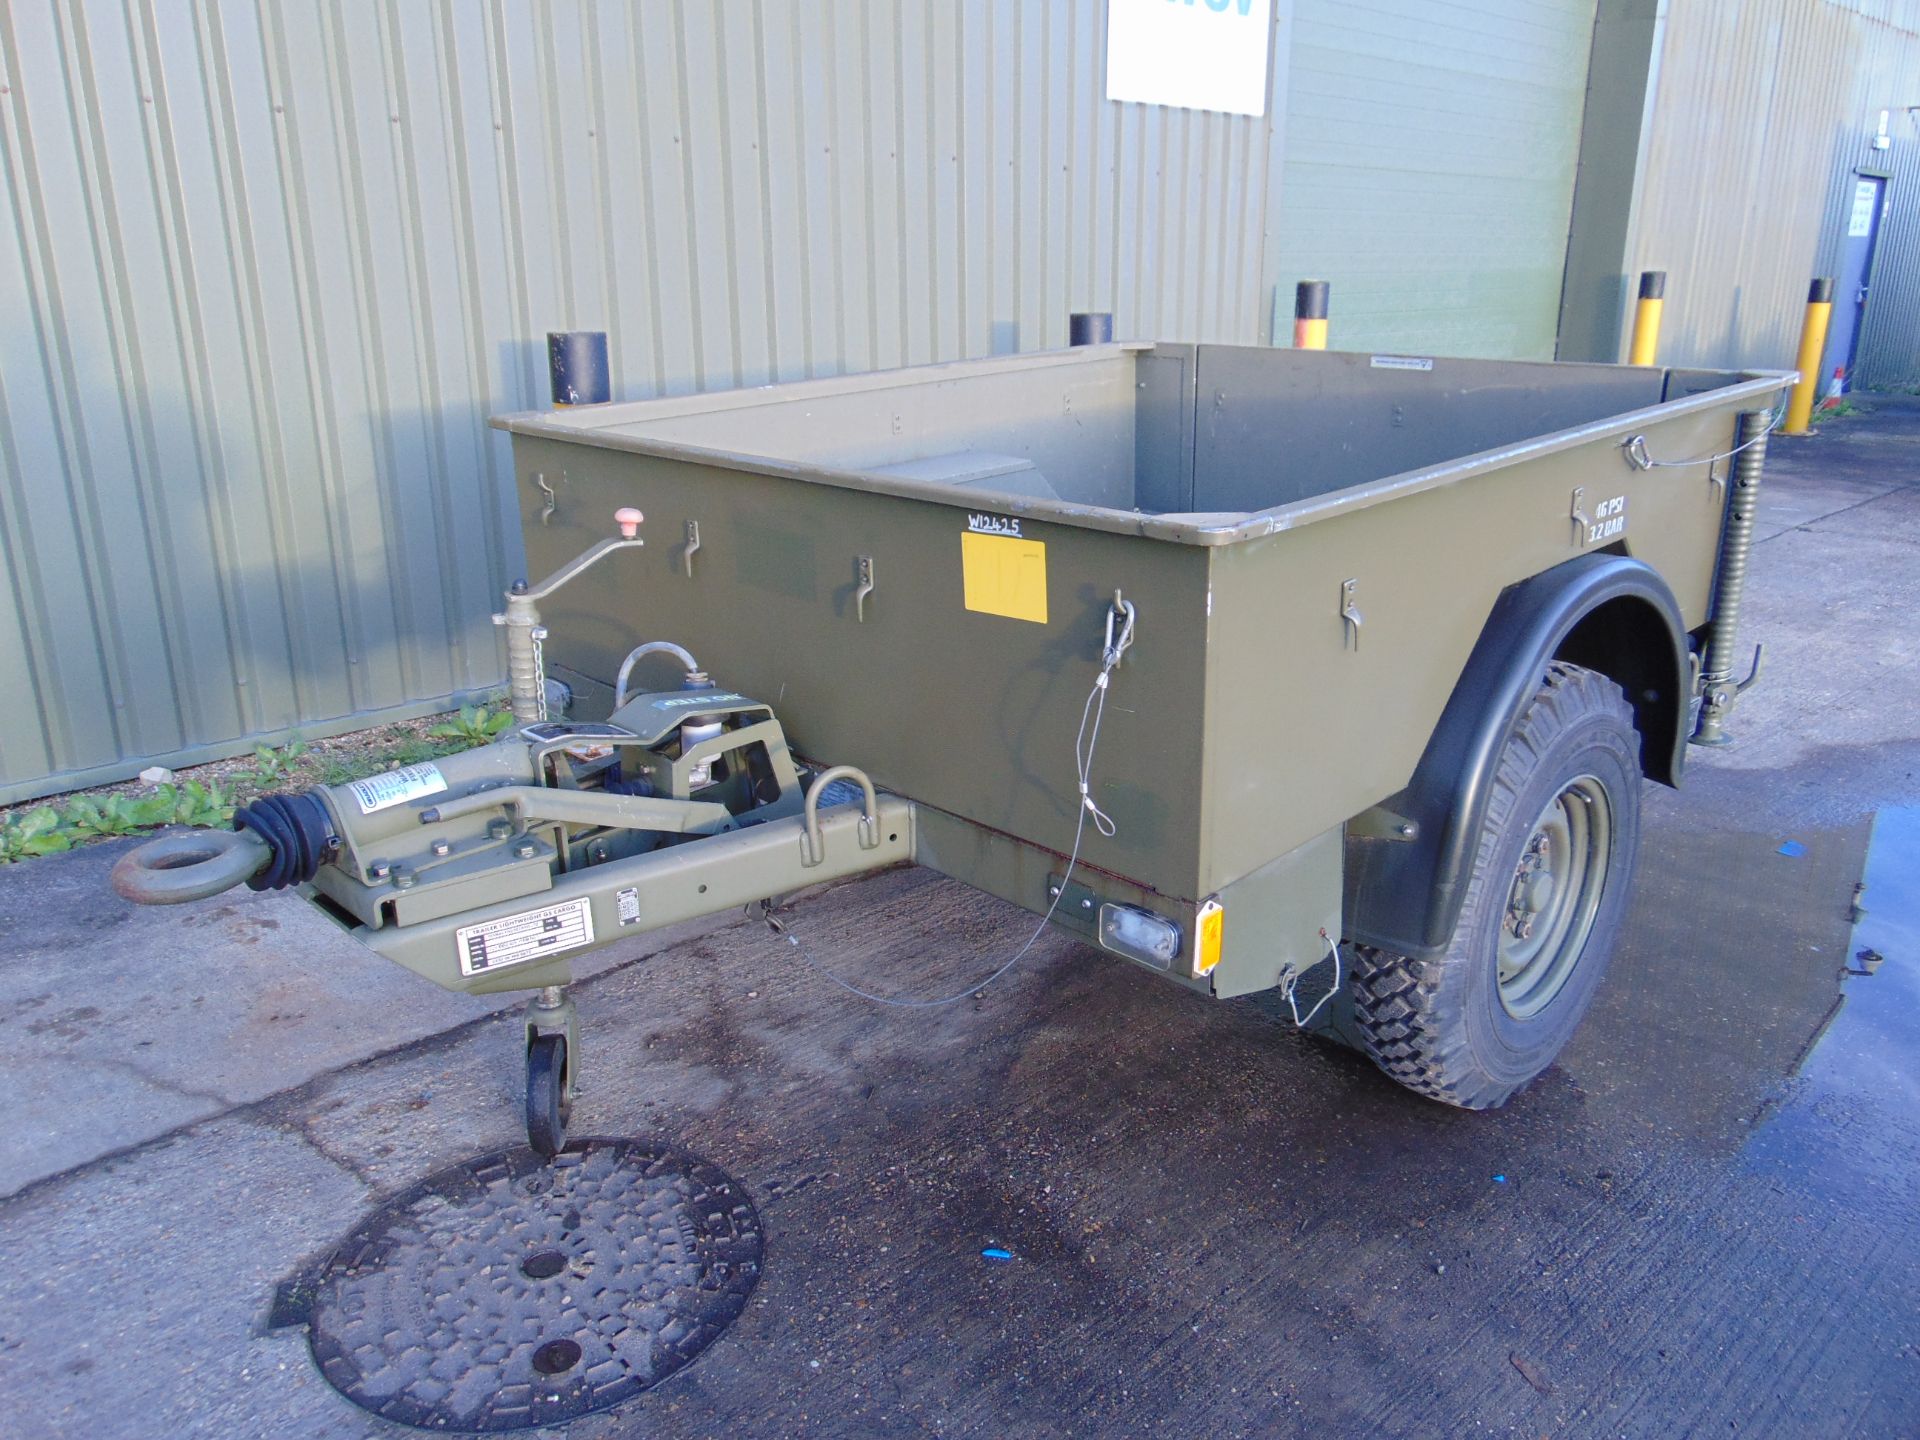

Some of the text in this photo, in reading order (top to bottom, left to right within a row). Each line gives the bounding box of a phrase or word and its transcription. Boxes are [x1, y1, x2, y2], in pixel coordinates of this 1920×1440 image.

[1596, 496, 1624, 518] 46 PSI
[1604, 516, 1623, 536] BAR
[472, 925, 498, 935] TRAILER
[500, 913, 542, 929] LIGHTWEIGHT
[554, 904, 576, 915] CARGO
